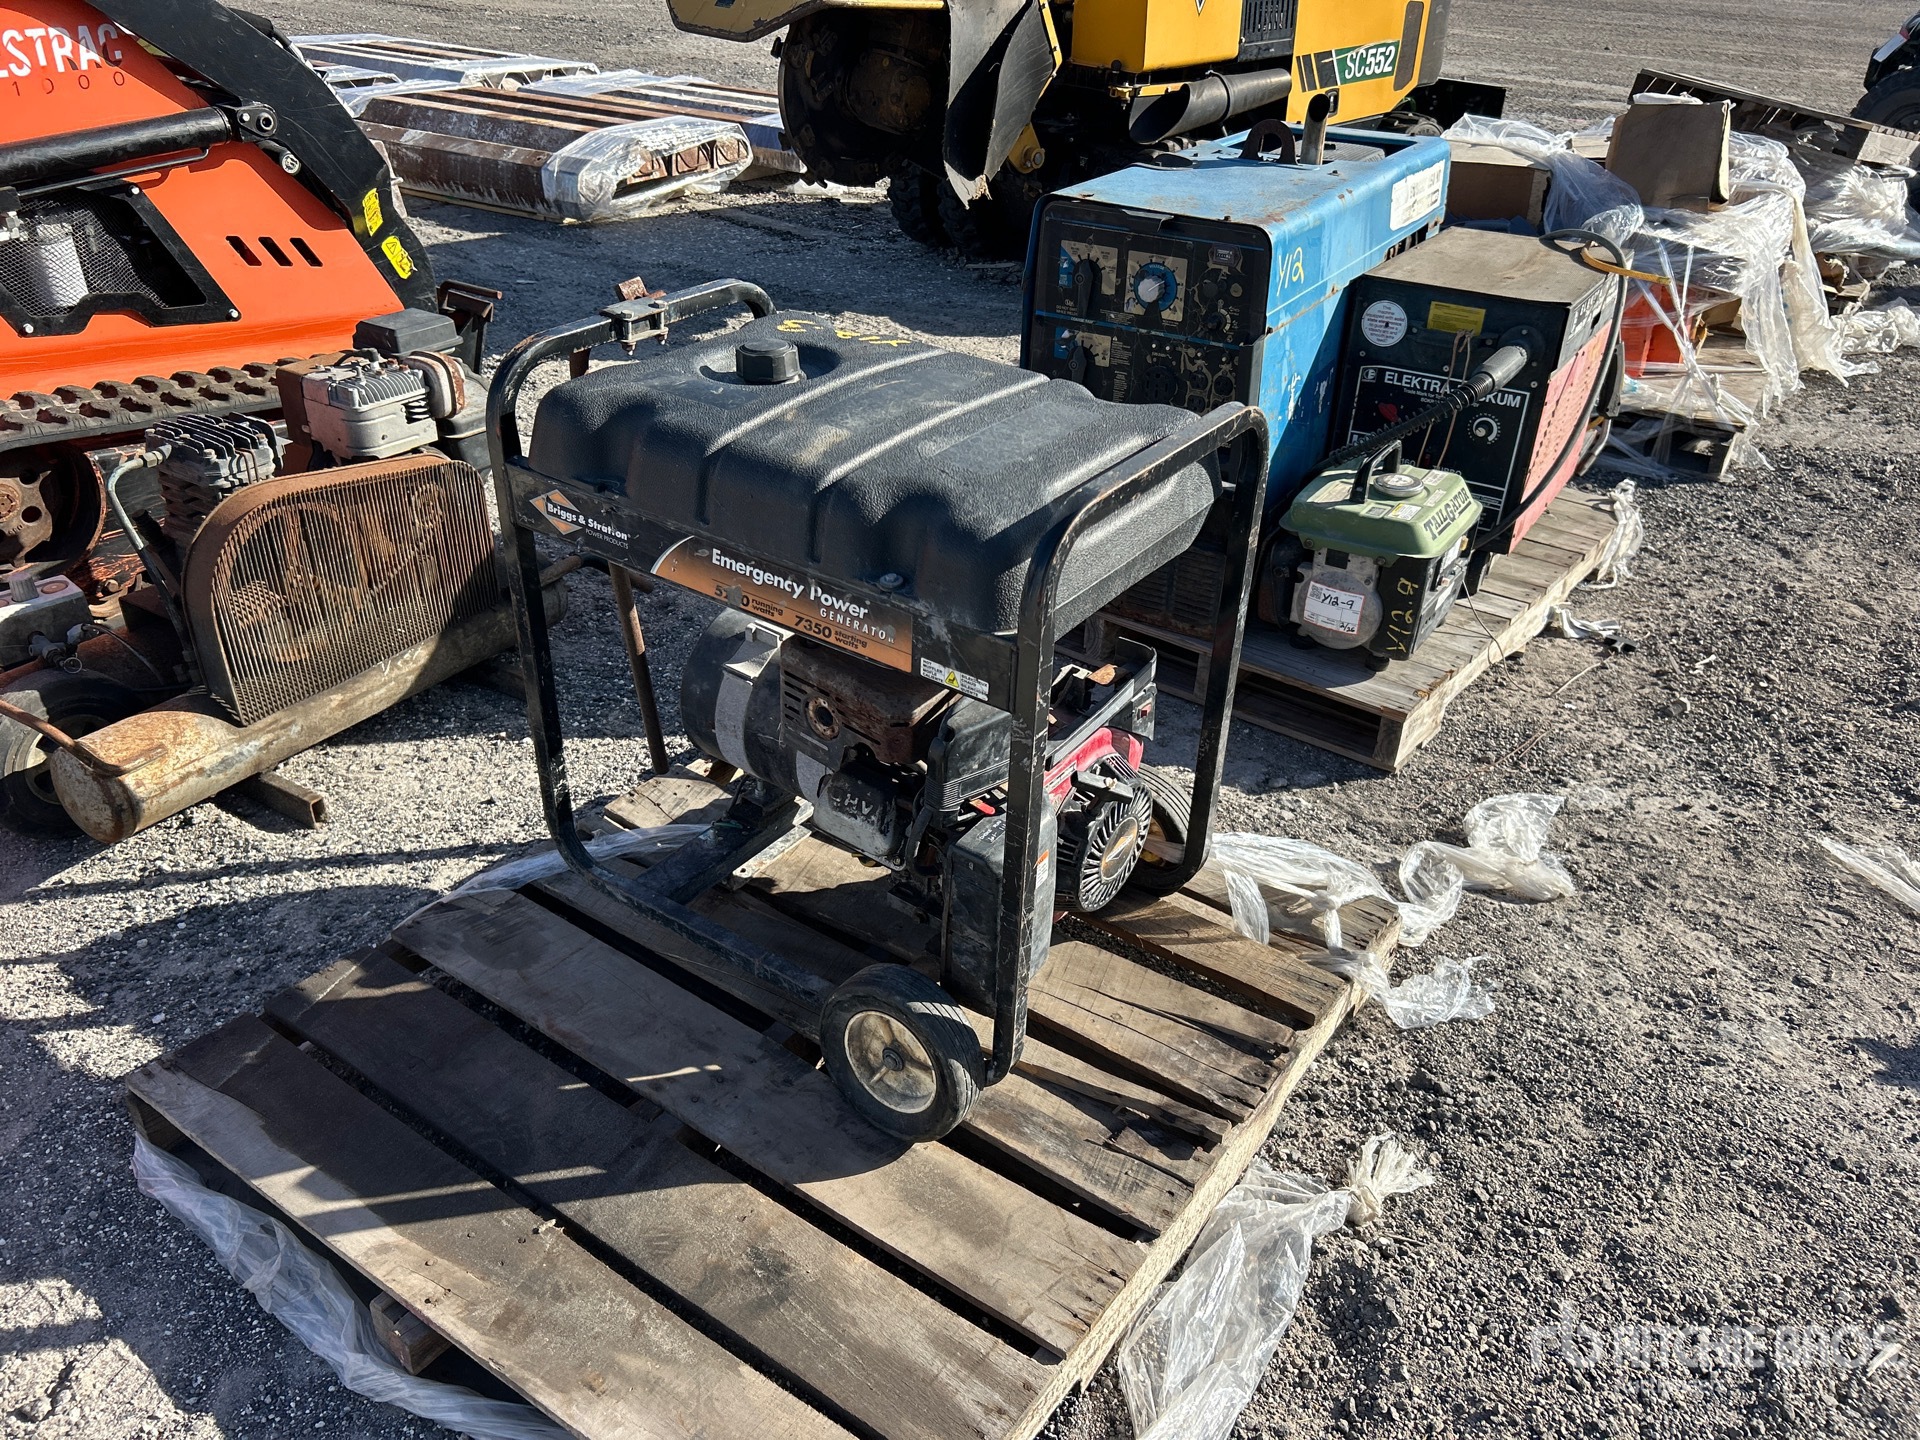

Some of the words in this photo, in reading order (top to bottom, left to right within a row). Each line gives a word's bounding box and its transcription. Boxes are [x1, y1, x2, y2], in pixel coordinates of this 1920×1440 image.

[0, 23, 122, 77] STRAC
[1345, 45, 1396, 79] SC552
[546, 502, 577, 523] Briggs
[577, 514, 587, 526] &
[585, 528, 604, 541] POWER
[603, 533, 630, 550] PRODUCTS
[712, 547, 805, 600] Emergency
[809, 585, 869, 619] Power
[751, 597, 784, 616] running
[751, 604, 775, 618] watts
[1321, 593, 1355, 609] Y12-9
[795, 615, 832, 639] 7350
[834, 629, 868, 648] starting
[834, 635, 859, 650] watts
